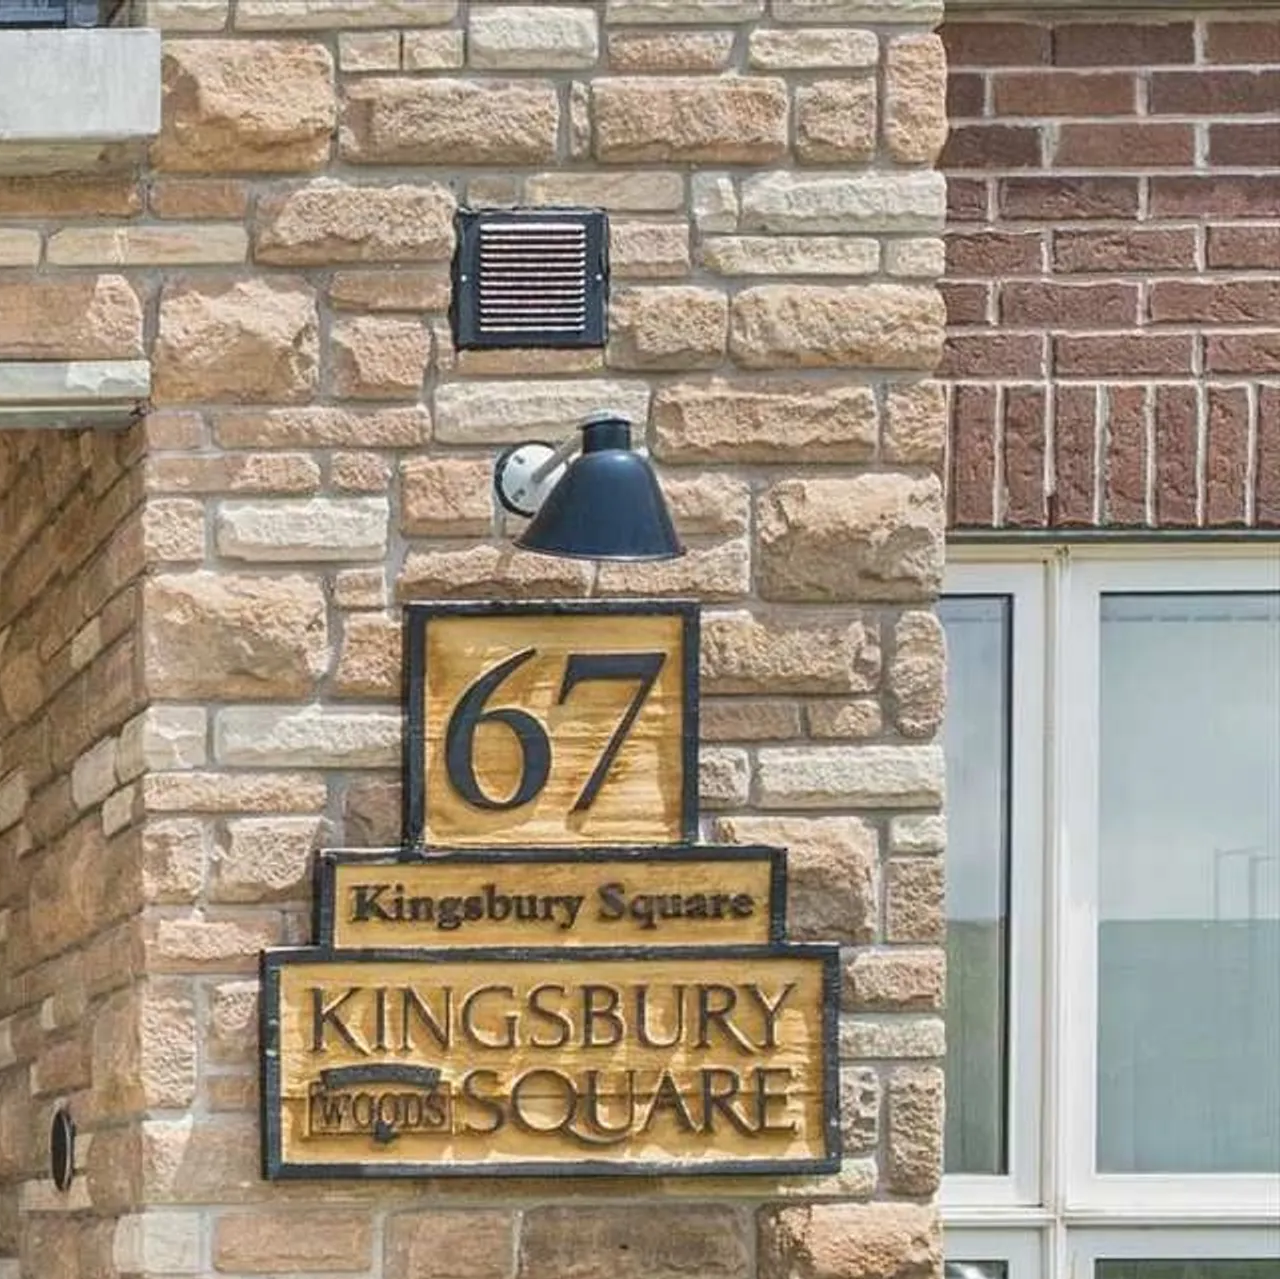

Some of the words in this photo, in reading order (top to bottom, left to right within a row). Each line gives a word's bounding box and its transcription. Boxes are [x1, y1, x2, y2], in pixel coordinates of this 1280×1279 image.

[444, 647, 667, 818] 67
[350, 884, 586, 930] Kingsbury
[597, 882, 754, 929] Square
[308, 983, 797, 1055] KINGSBURY
[321, 1091, 446, 1129] WOODS
[460, 1066, 799, 1145] SQUARE
